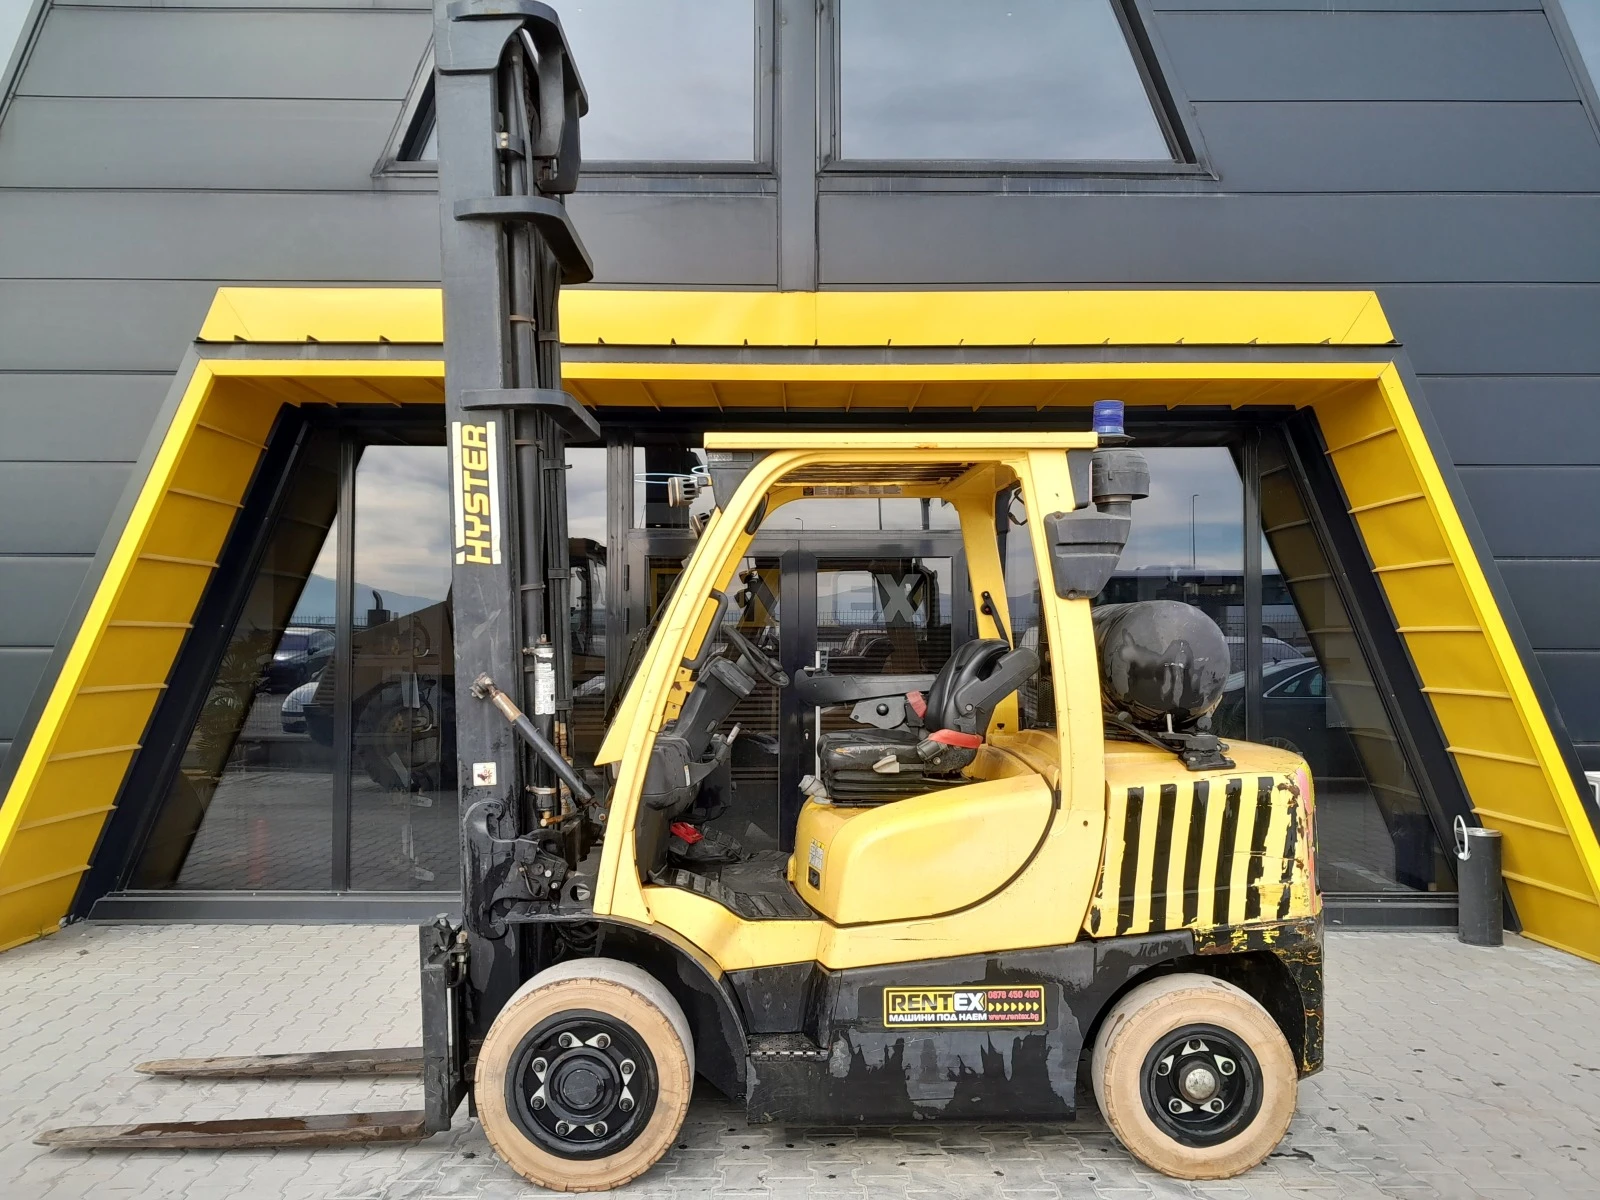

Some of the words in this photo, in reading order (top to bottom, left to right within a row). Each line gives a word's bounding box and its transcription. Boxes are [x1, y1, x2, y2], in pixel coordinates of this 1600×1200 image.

[462, 424, 491, 565] HYSTER
[892, 992, 984, 1012] RENTEX
[1008, 990, 1023, 999] 450
[889, 1013, 935, 1022] МАШИНИ
[937, 1013, 957, 1022] ПОД
[959, 1012, 987, 1021] НАЕМ
